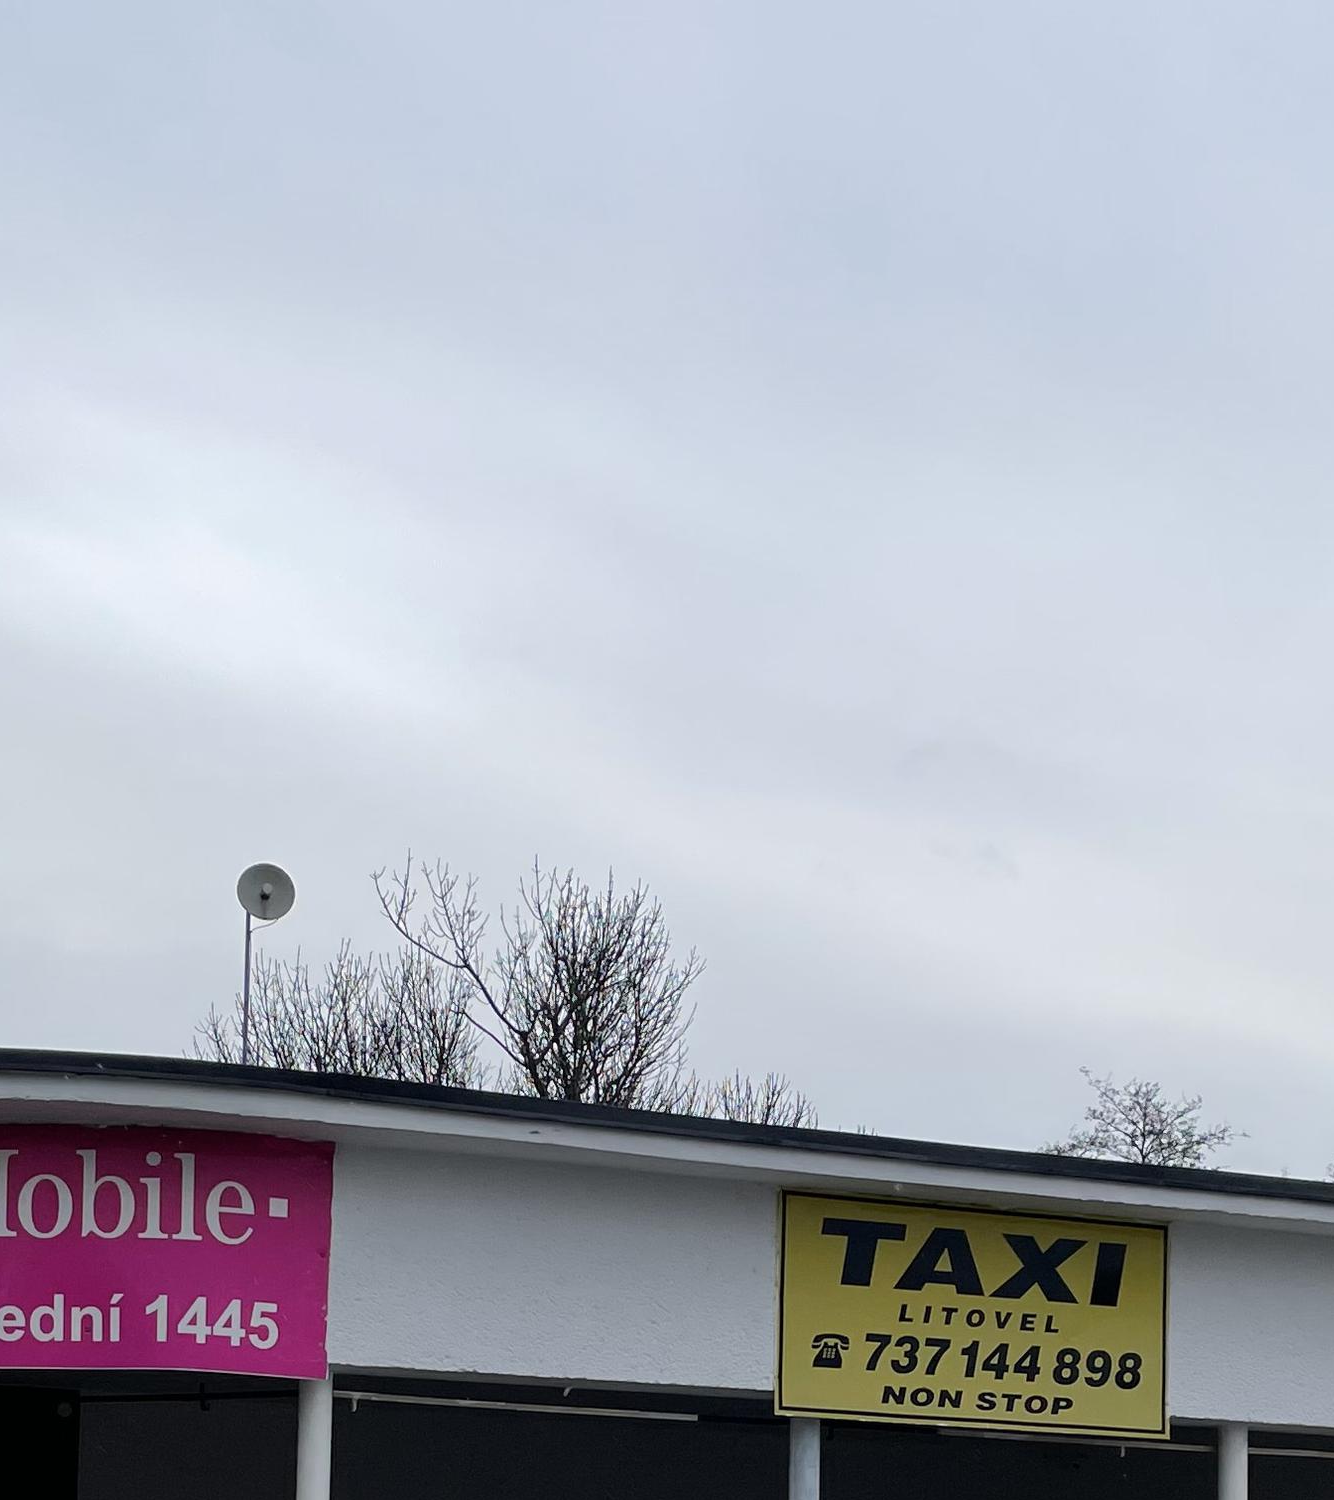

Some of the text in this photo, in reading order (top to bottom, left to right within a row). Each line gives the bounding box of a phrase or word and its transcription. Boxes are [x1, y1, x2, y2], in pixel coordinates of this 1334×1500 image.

[821, 1217, 1128, 1307] TAXI
[145, 1294, 280, 1350] 1445
[898, 1303, 1060, 1333] LITOVEL
[864, 1332, 1143, 1390] 737 144 898
[881, 1386, 1074, 1415] NON STOP
